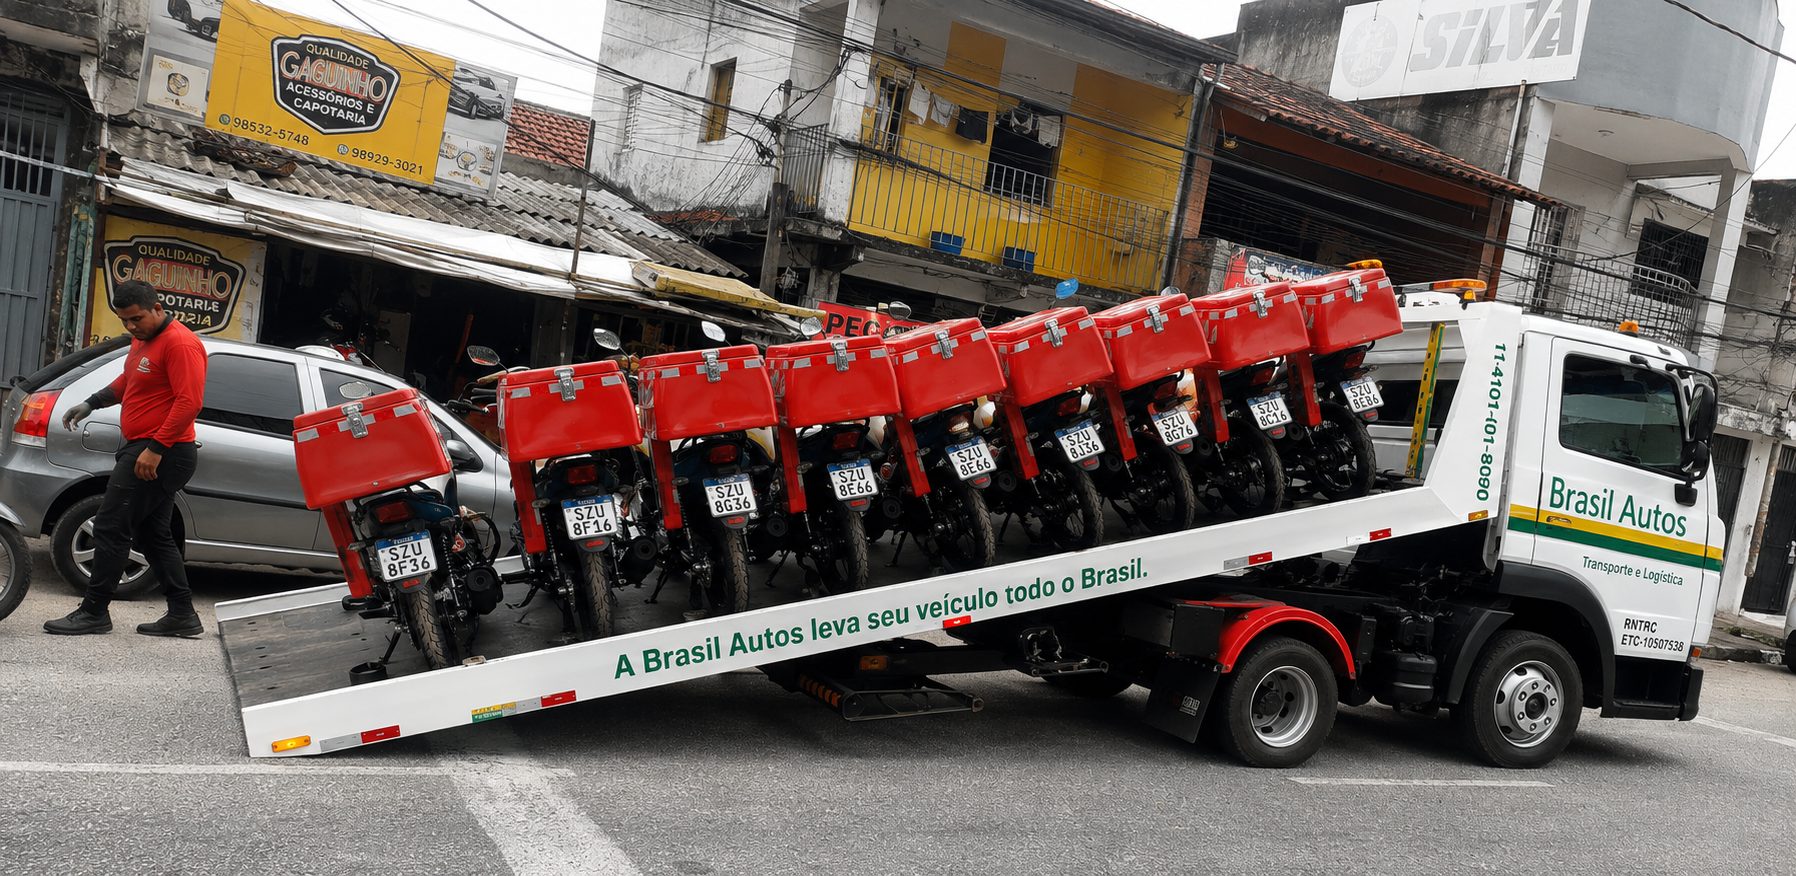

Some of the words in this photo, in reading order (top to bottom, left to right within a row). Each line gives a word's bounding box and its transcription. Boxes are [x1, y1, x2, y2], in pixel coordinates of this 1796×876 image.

[306, 43, 370, 70] QUALIDADE
[280, 50, 387, 102] GAGUINHO
[285, 81, 363, 111] ACESSÓRIOS
[367, 102, 375, 114] E
[293, 97, 367, 126] CAPOTARIA
[233, 117, 310, 146] 98532-5748
[351, 147, 424, 176] 98929-3021
[138, 244, 211, 266] QUALIDADE
[112, 254, 232, 299] GAGUINHO
[1352, 384, 1372, 397] SZU
[1257, 400, 1280, 414] SZU
[1161, 414, 1185, 430] SZU
[1260, 411, 1287, 427] 8C16
[1066, 429, 1091, 446] SZU
[1166, 425, 1194, 443] 8G76
[956, 446, 983, 463] SZU
[1070, 441, 1100, 459] 8J36
[839, 468, 866, 483] SZU
[960, 459, 991, 476] 8E66
[715, 483, 744, 498] SZU
[839, 480, 873, 496] 8E66
[574, 504, 605, 521] SZU
[715, 496, 751, 513] 8G36
[1549, 476, 1615, 521] Brasil
[1618, 494, 1687, 538] Autos
[572, 518, 613, 535] 8F16
[388, 541, 423, 562] SZU
[387, 557, 431, 577] 8F36
[1582, 556, 1633, 577] Transporte
[1635, 569, 1641, 578] e
[1643, 567, 1683, 586] Logística
[614, 653, 635, 680] A
[642, 636, 721, 675] Brasil
[728, 624, 804, 657] Autos
[811, 611, 861, 643] leva
[867, 605, 910, 629] seu
[915, 586, 998, 623] veículo
[1004, 575, 1055, 605] todo
[1062, 575, 1075, 592] o
[1081, 557, 1148, 590] Brasil.
[1623, 618, 1657, 633] RNTRC
